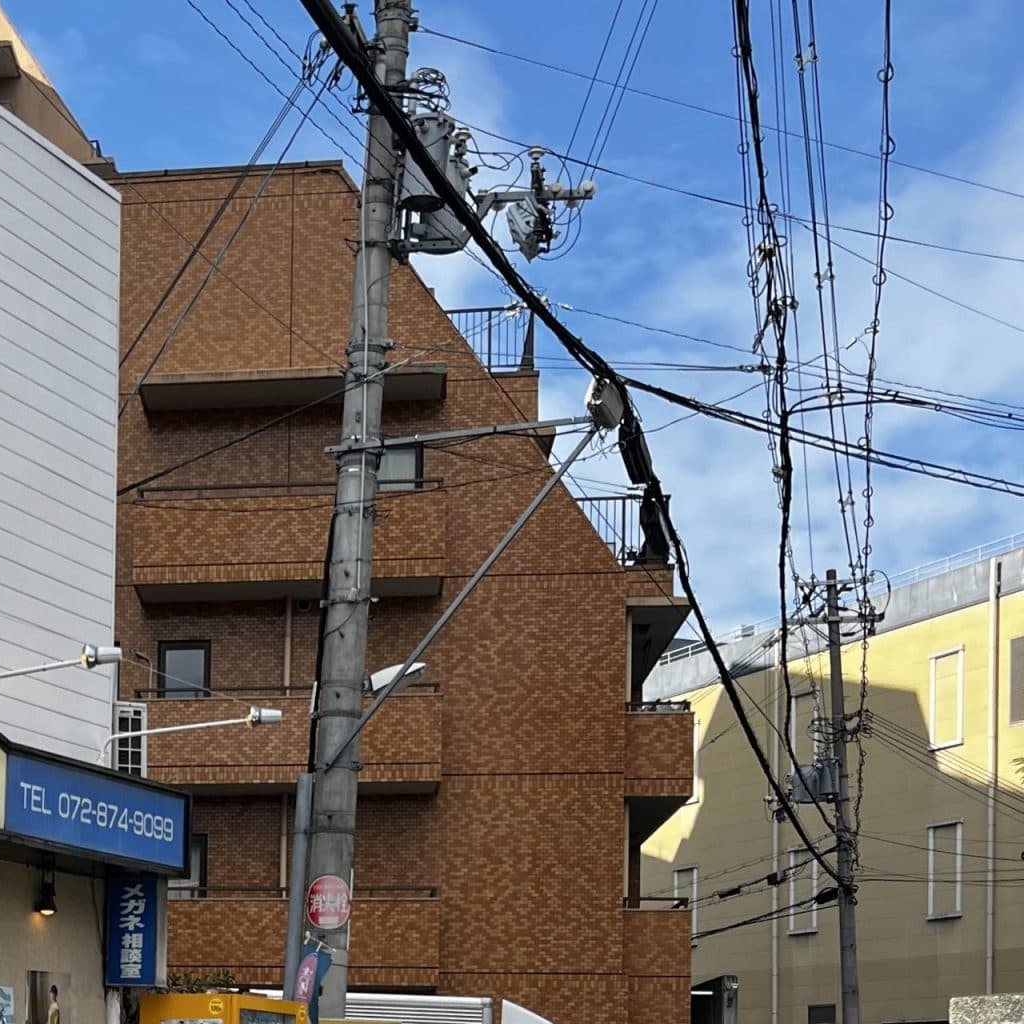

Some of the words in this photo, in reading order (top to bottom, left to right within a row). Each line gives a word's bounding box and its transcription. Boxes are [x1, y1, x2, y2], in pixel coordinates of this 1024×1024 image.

[20, 781, 52, 815] TEL
[58, 793, 174, 842] 072-874-9099
[119, 883, 146, 979] メガネ相談室
